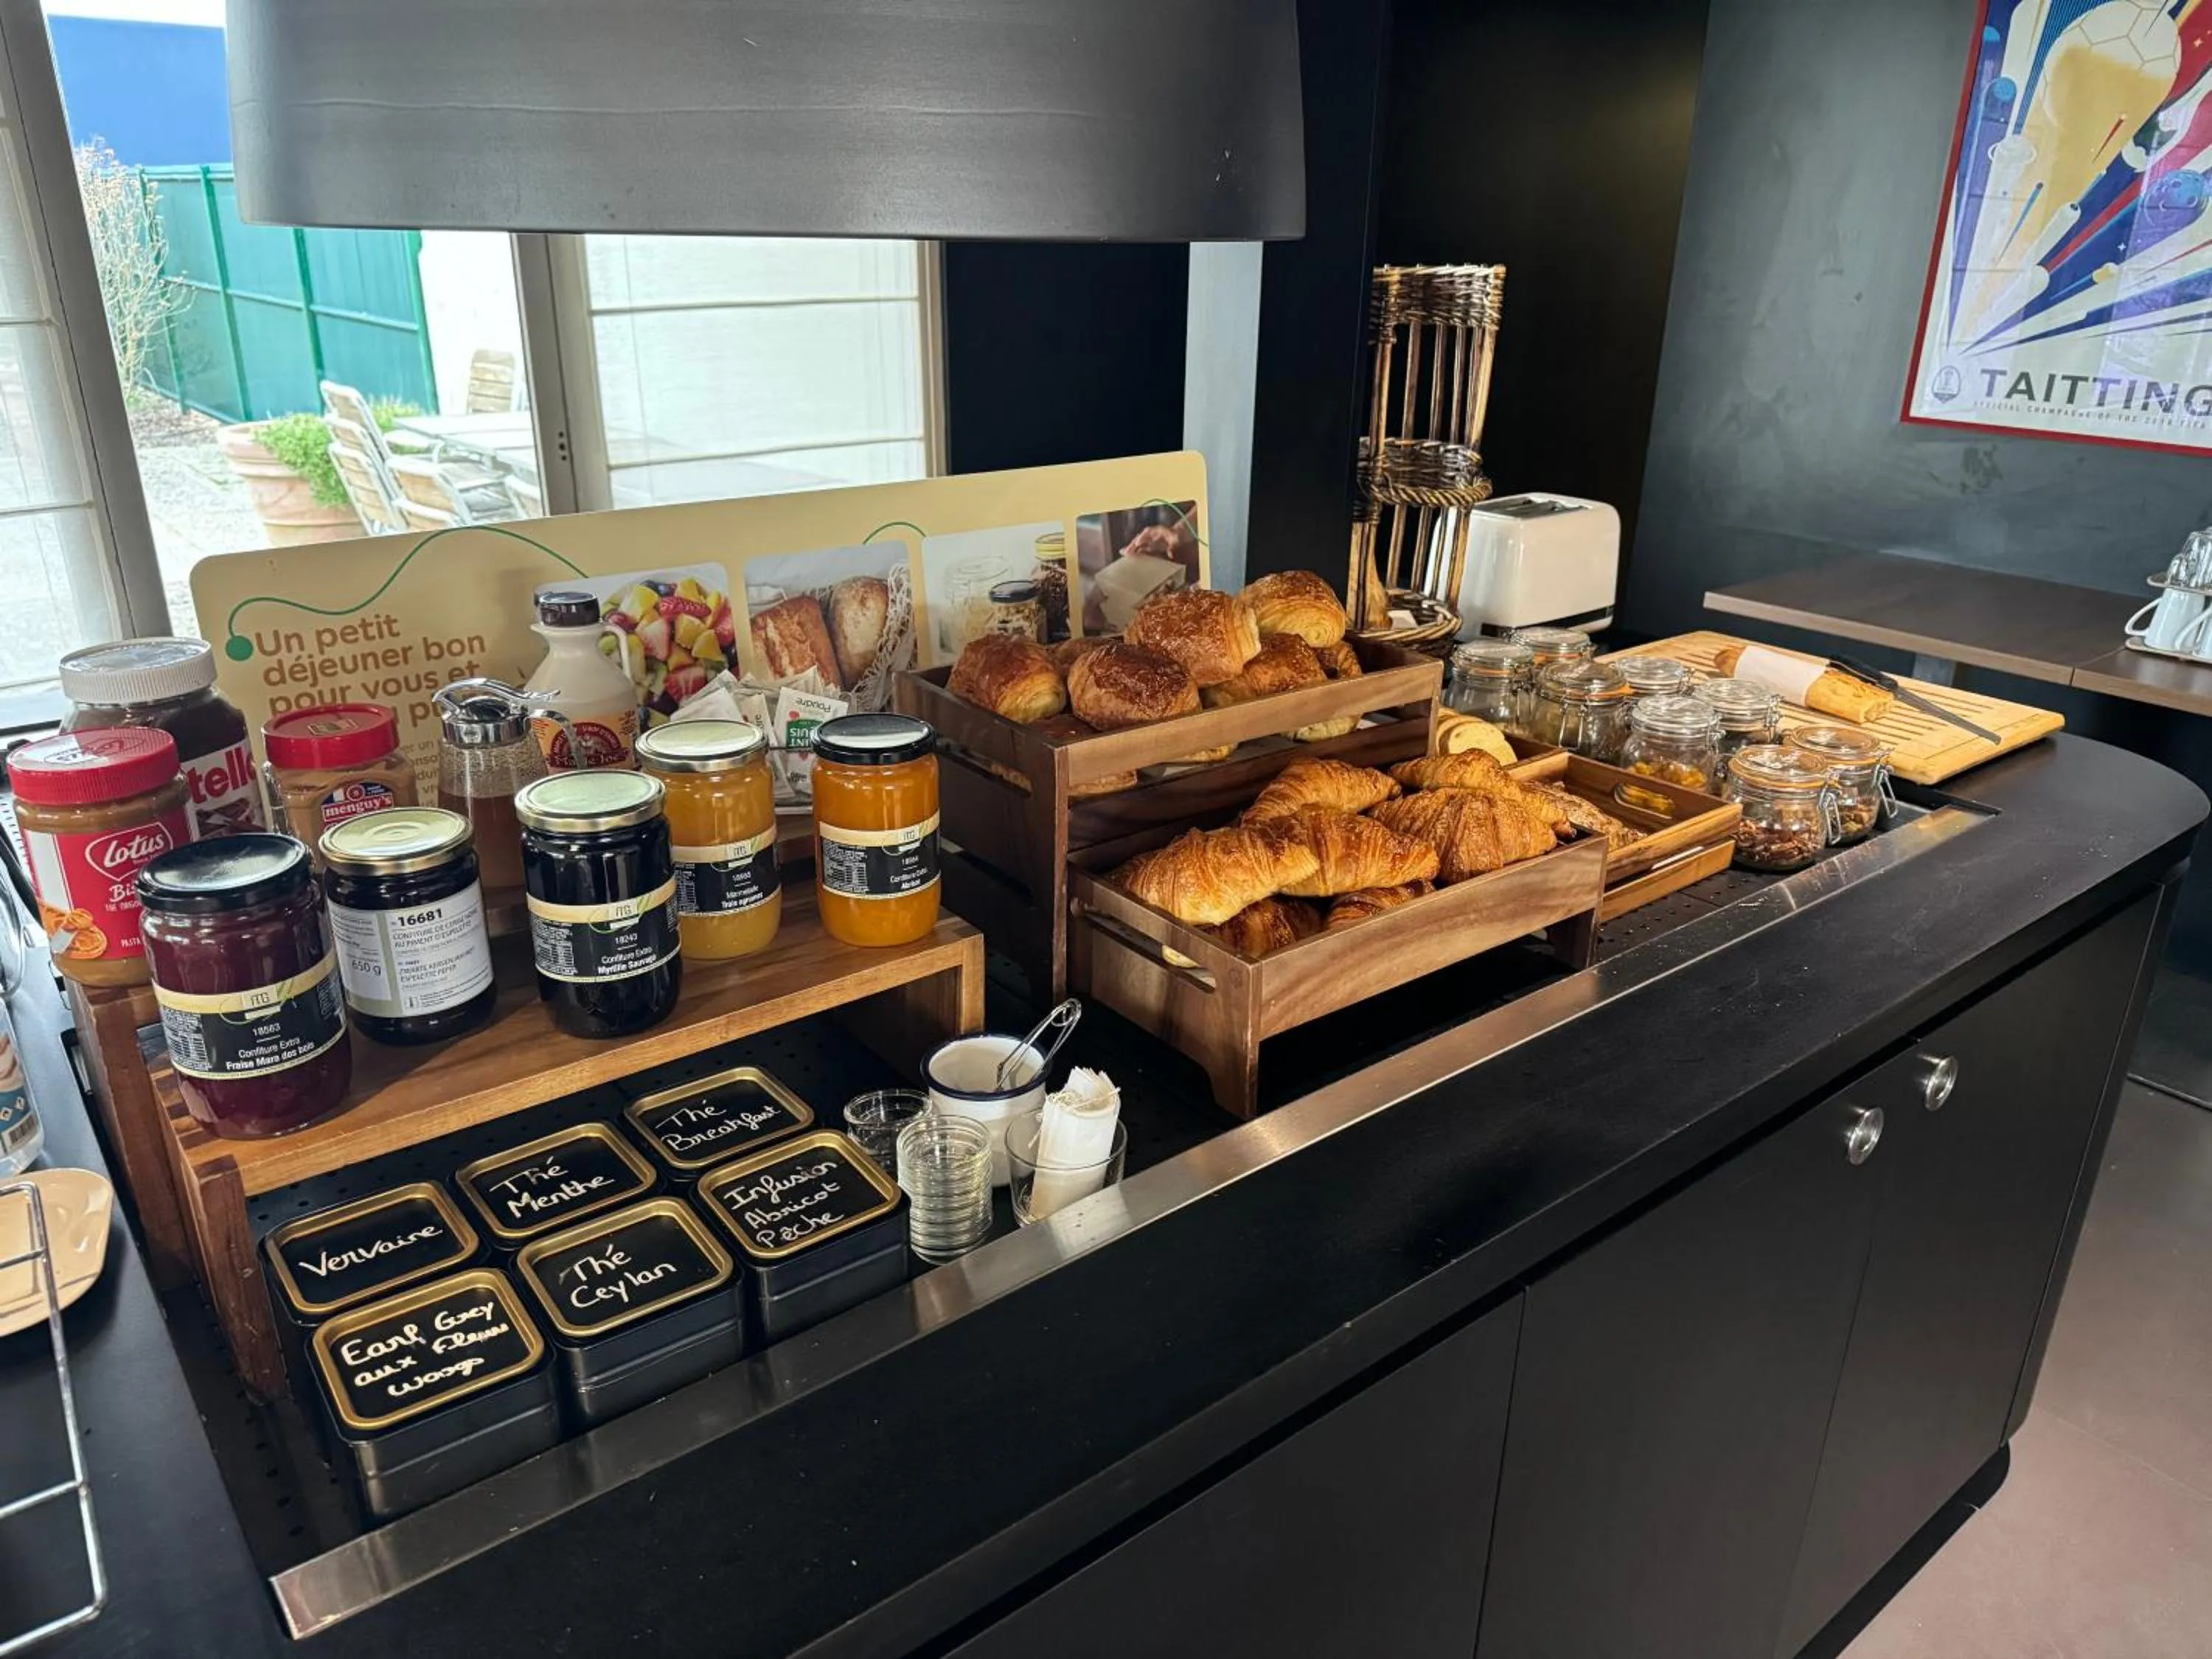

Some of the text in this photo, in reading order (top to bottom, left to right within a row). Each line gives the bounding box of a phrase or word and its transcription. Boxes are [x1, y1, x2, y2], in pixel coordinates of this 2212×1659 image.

[1980, 368, 2212, 417] TAITTING
[256, 614, 400, 656] Un petit
[263, 635, 486, 687] déjeuner bon
[362, 672, 439, 700] vous
[448, 661, 481, 684] et
[325, 796, 392, 817] menguy's
[103, 833, 165, 869] Lotus
[398, 908, 442, 927] 16681
[352, 959, 381, 977] 650 g
[226, 1060, 254, 1071] Fraise
[238, 1044, 278, 1058] Confiture
[655, 1099, 728, 1128] Thé
[661, 1105, 782, 1152] Breakfast
[489, 1155, 568, 1194] Thé
[723, 1161, 838, 1210] Infusion
[507, 1174, 615, 1220] Menthe
[744, 1180, 841, 1230] Abricot
[756, 1211, 846, 1248] Pêche
[558, 1242, 632, 1286] Thé
[570, 1262, 678, 1308] Ceylan
[341, 1301, 495, 1367] Earl Grey
[354, 1355, 418, 1387] aux
